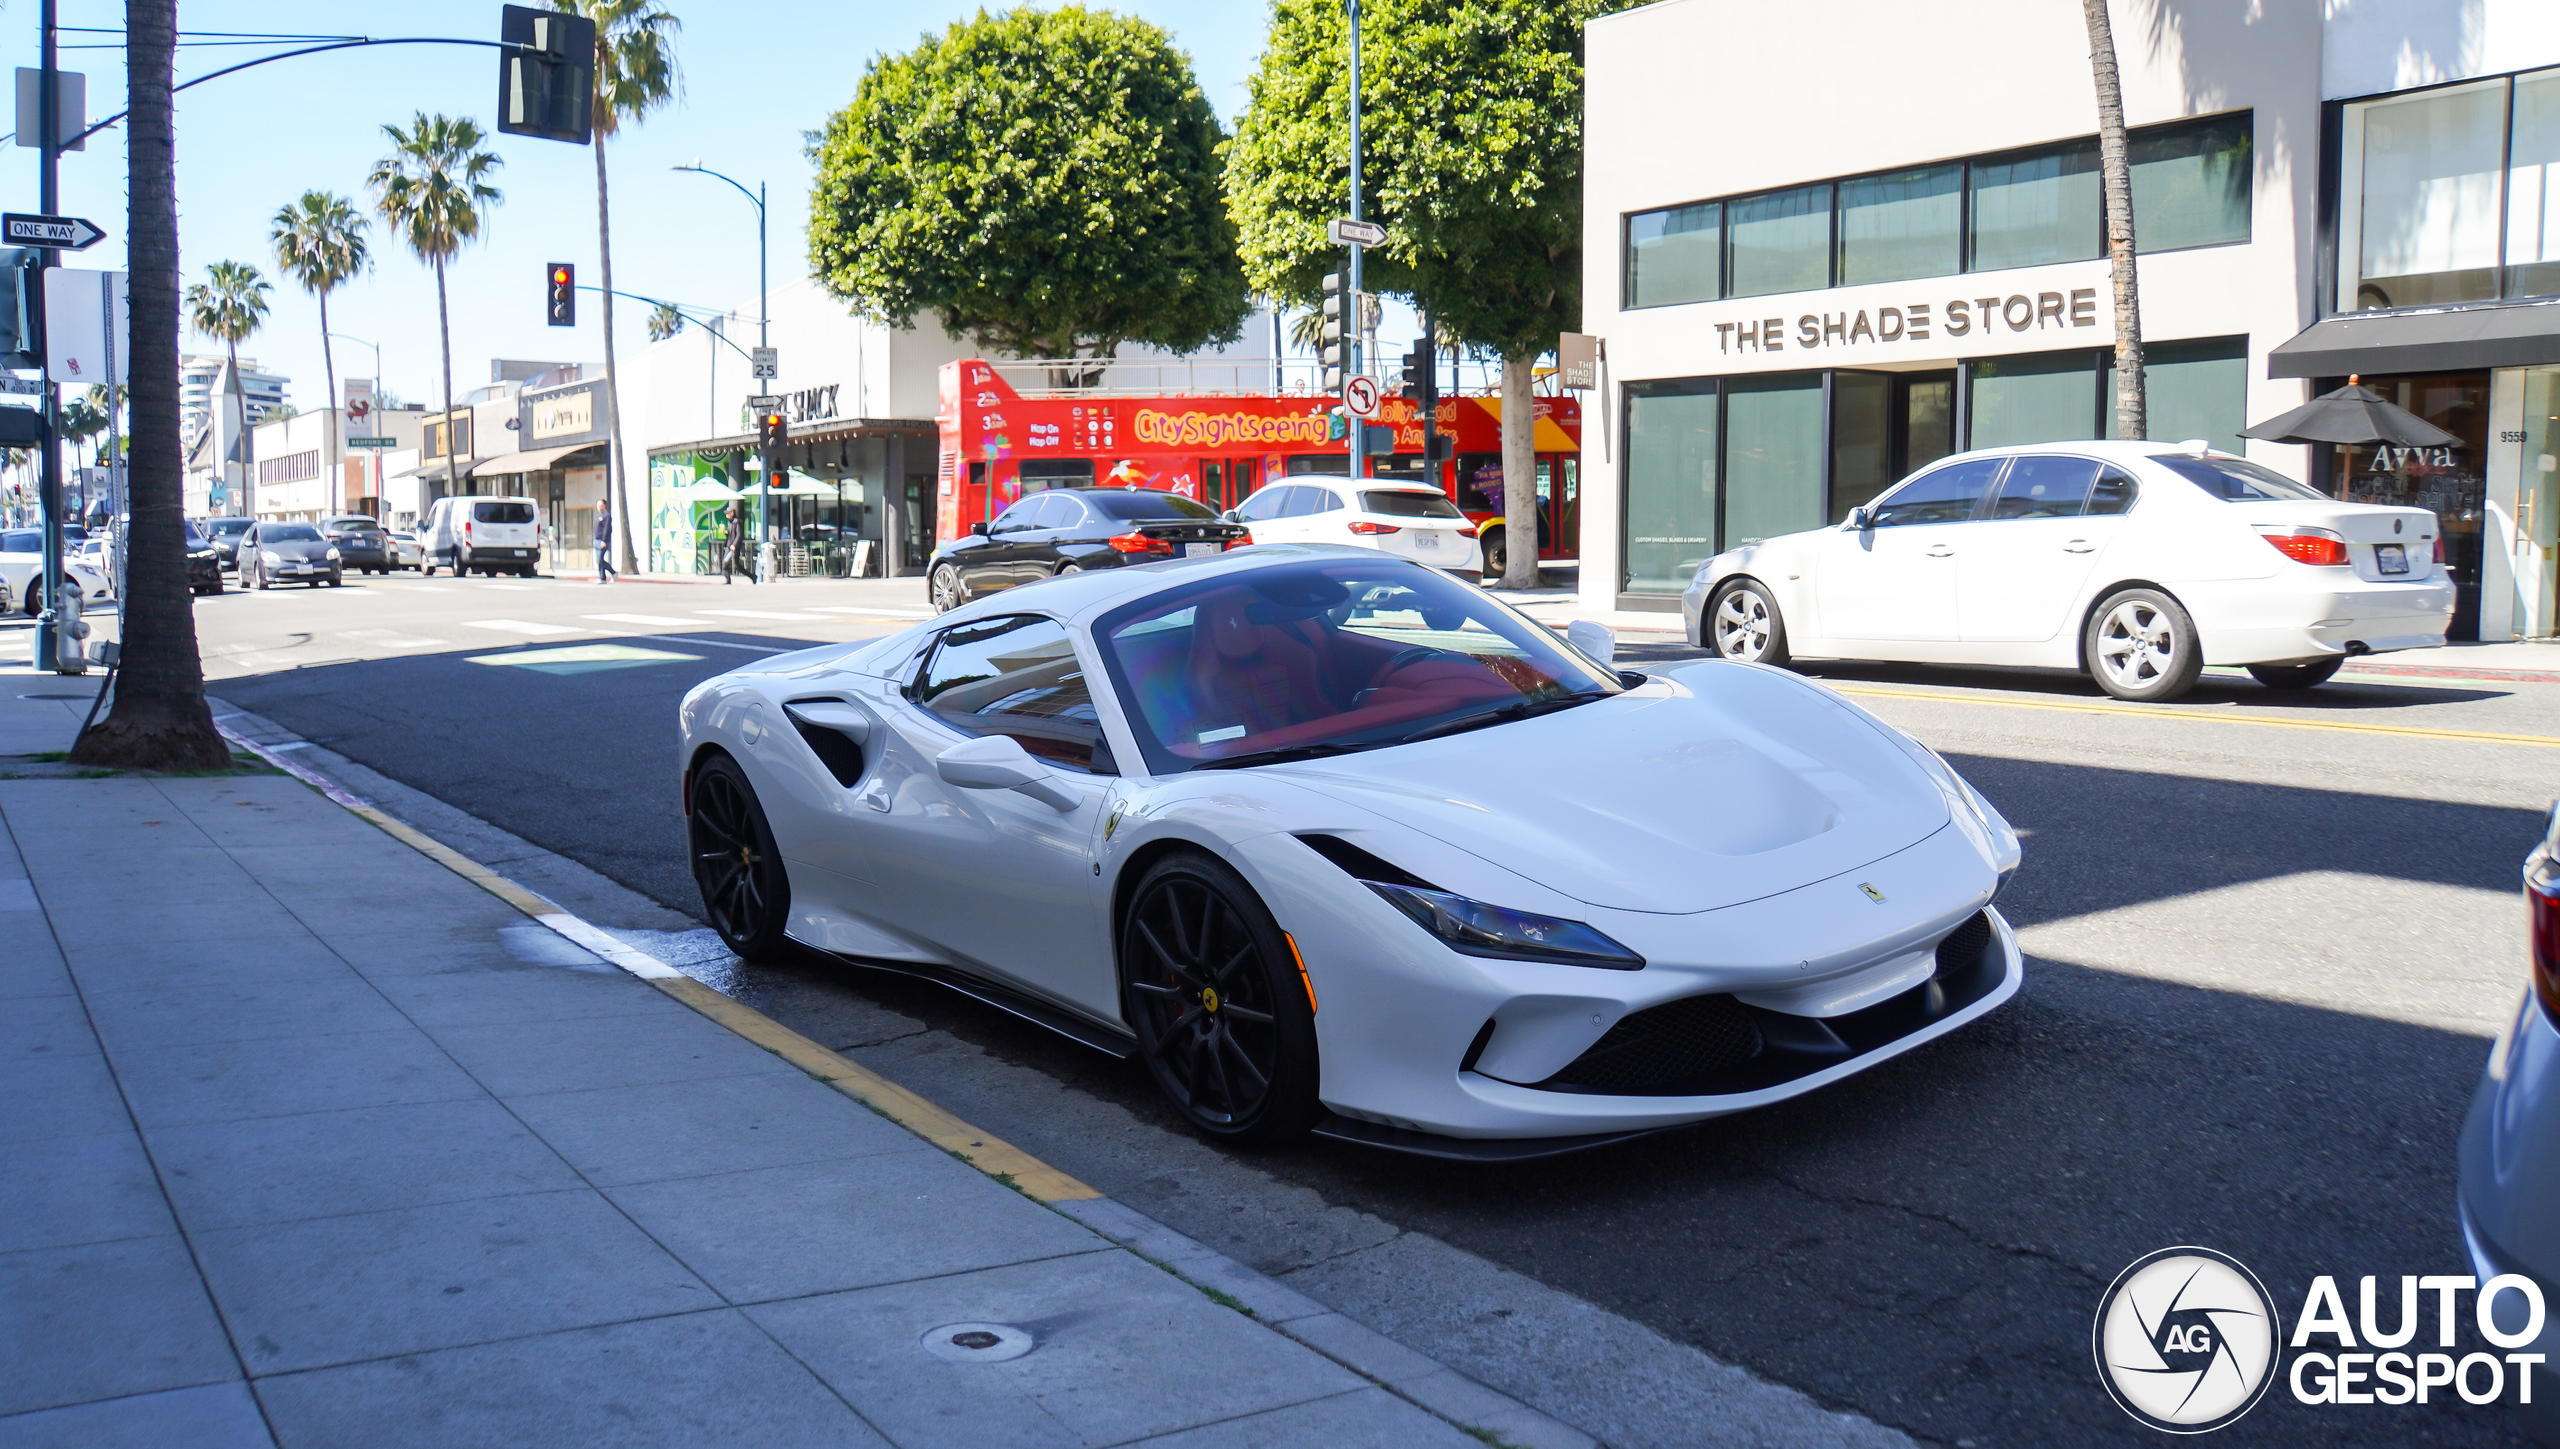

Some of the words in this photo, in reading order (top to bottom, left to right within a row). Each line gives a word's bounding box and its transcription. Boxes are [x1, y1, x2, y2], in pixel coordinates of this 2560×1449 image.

[14, 222, 42, 237] ONE
[47, 225, 76, 239] WAY
[1342, 225, 1358, 236] ONE
[1360, 229, 1374, 239] WAY
[1714, 318, 1784, 355] THE
[1797, 303, 1930, 349] SHADE
[1944, 287, 2097, 336] STORE
[755, 364, 775, 377] 25
[1578, 360, 1594, 370] THE
[1566, 367, 1594, 378] SHADE
[1566, 375, 1594, 386] STORE
[793, 383, 840, 423] SHACK
[982, 415, 991, 430] 3
[1030, 423, 1047, 435] Hop
[1047, 423, 1060, 434] On
[1135, 409, 1330, 446] CitySightseeing
[1029, 436, 1046, 448] Hop
[1046, 435, 1060, 446] Off
[2500, 431, 2528, 443] 9559
